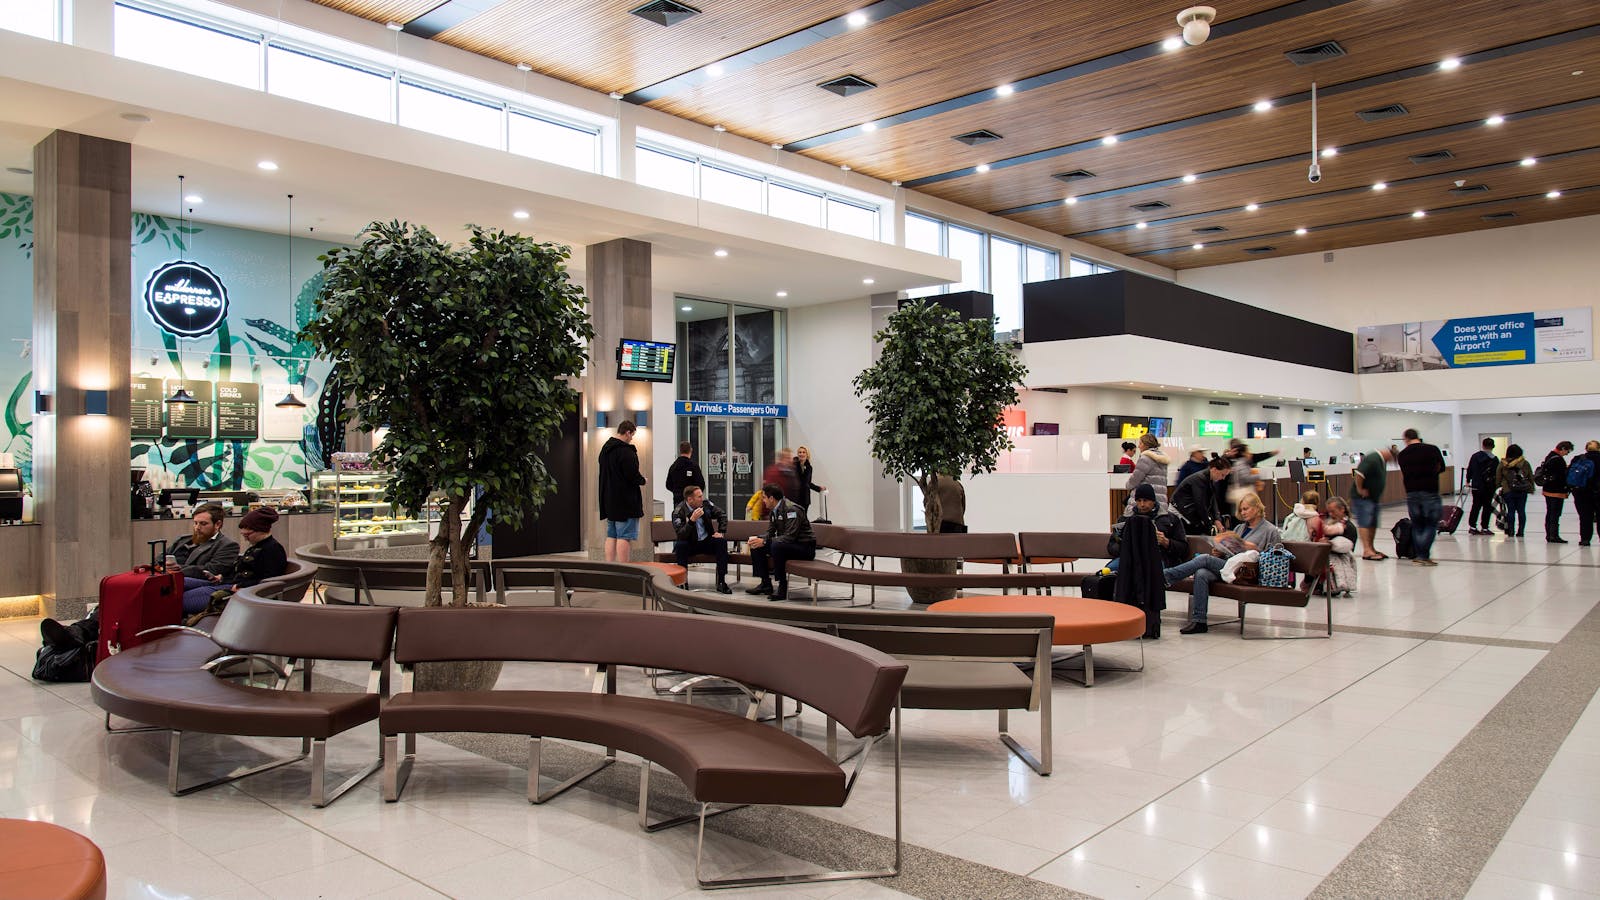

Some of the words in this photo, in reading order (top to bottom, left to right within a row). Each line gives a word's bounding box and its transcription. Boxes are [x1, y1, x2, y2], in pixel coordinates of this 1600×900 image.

[1454, 326, 1477, 334] Does
[1477, 324, 1498, 334] your
[1499, 321, 1525, 330] office
[1454, 334, 1478, 342] come
[1480, 332, 1499, 340] with
[1454, 341, 1491, 351] Airport?
[694, 403, 723, 412] Arrivals
[728, 404, 764, 415] Passengers
[764, 406, 780, 416] Only
